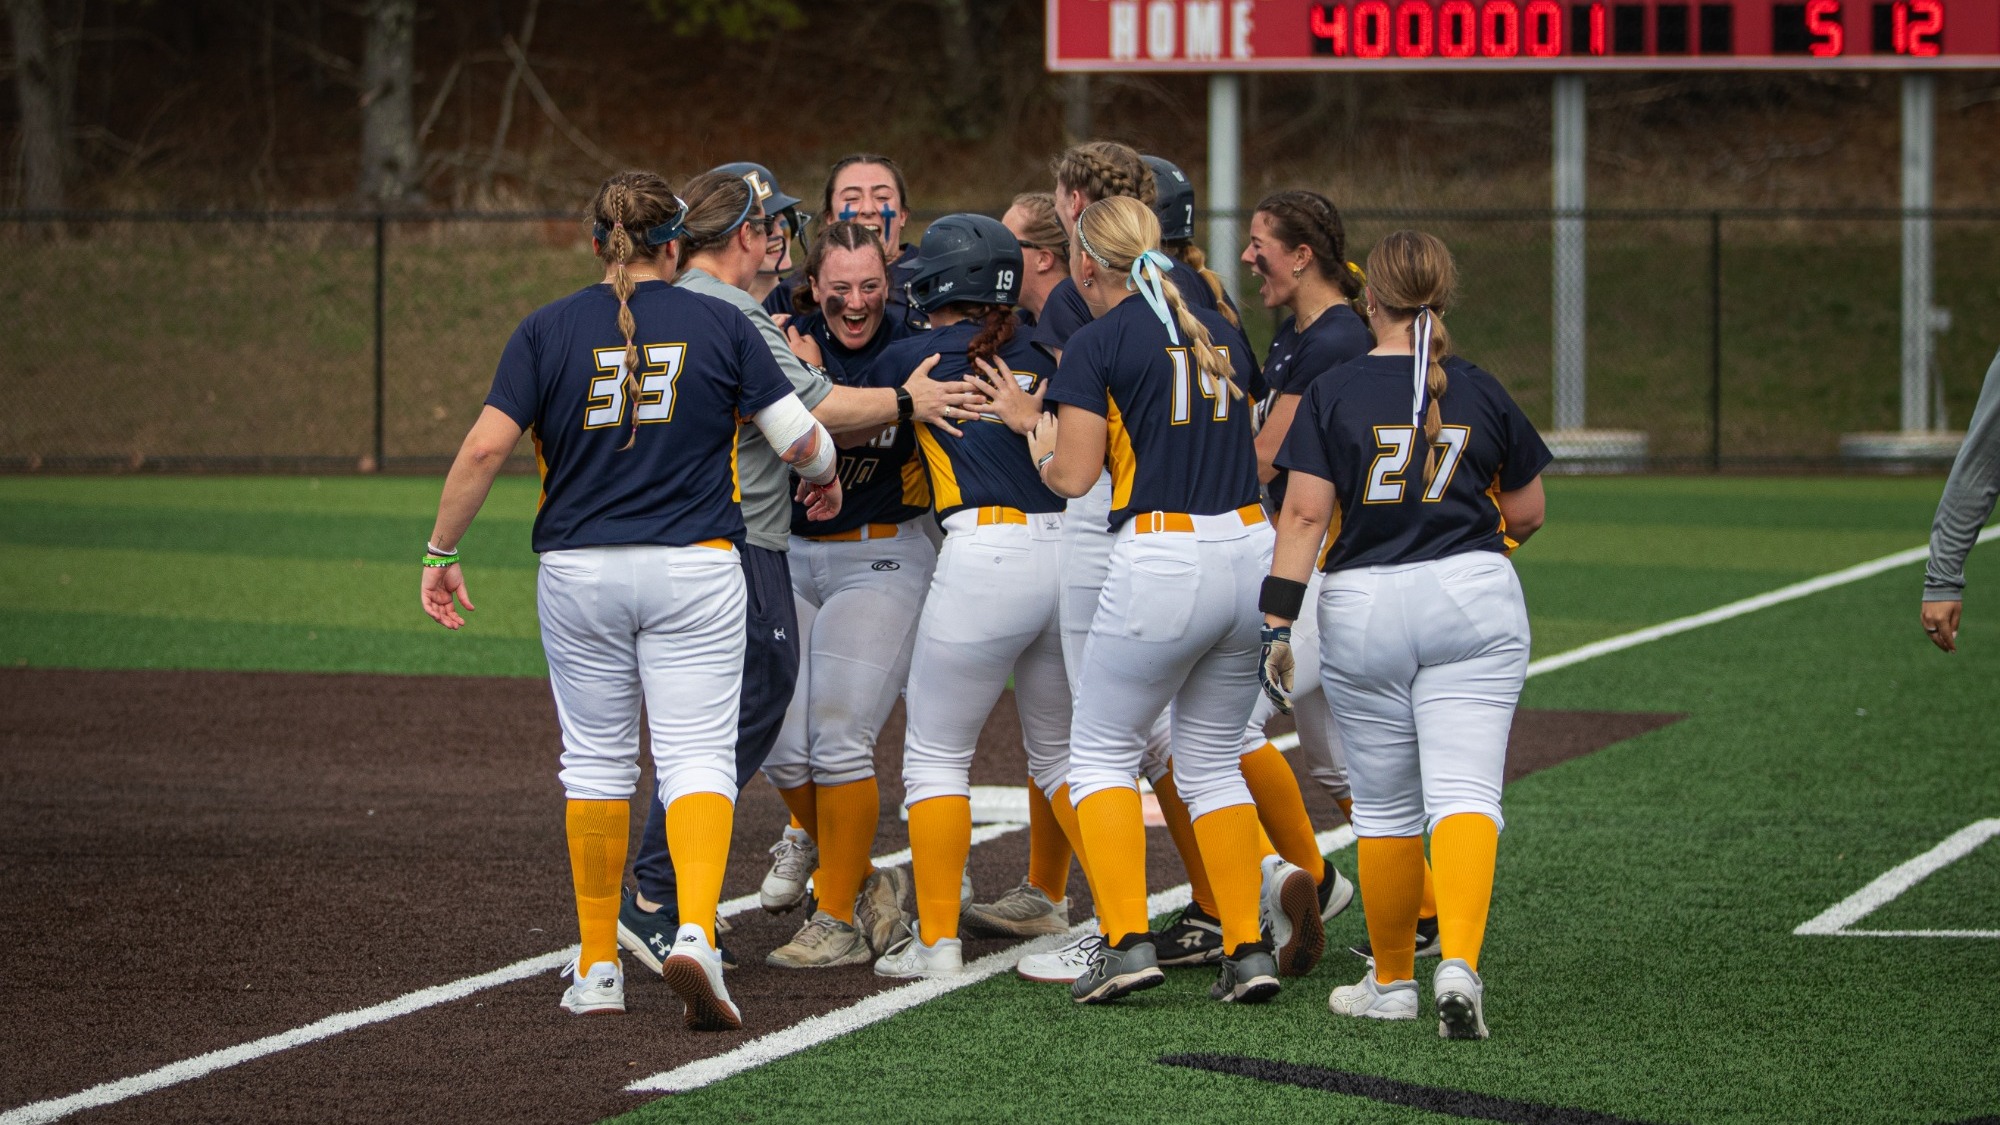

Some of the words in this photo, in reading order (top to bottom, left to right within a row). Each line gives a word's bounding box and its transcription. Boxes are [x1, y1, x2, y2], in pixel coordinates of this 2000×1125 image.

[1109, 0, 1254, 60] HOME
[1805, 0, 1844, 57] 5
[1892, 0, 1944, 57] 12
[743, 170, 773, 200] L
[1185, 204, 1193, 225] 7
[996, 269, 1014, 290] 19
[583, 343, 687, 430] 33
[1165, 346, 1231, 425] 14
[1362, 424, 1471, 504] 27
